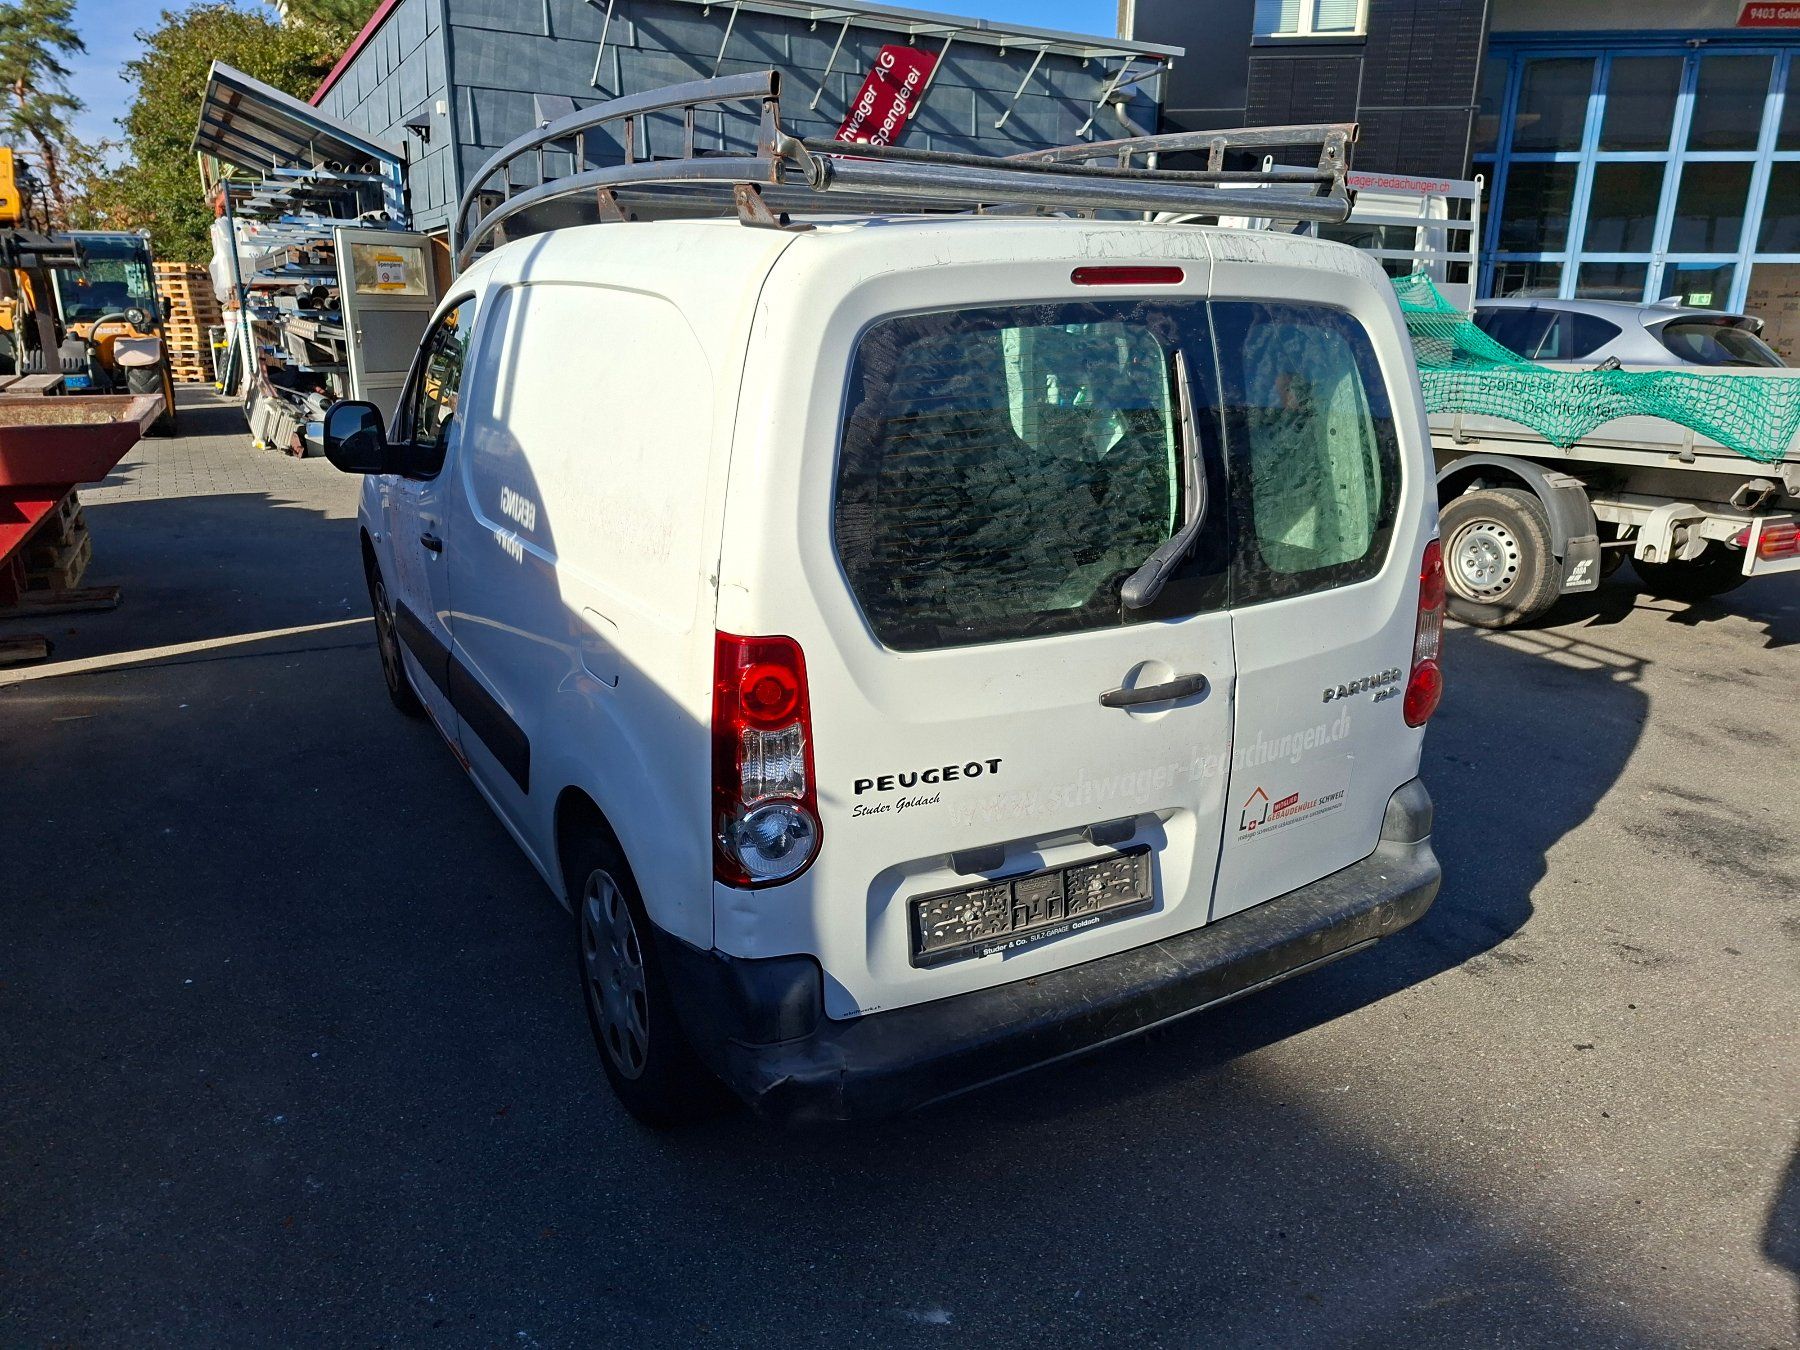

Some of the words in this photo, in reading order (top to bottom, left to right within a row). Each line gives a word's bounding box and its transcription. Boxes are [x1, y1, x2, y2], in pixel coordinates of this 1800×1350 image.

[1751, 8, 1775, 19] 9403
[875, 52, 895, 82] AG
[870, 65, 921, 146] Spenglerei
[1323, 667, 1402, 703] PARTNER
[854, 758, 1002, 795] PEUGEOT
[852, 803, 891, 818] Studer
[896, 792, 941, 813] Goldach
[1319, 789, 1344, 805] SCHWEIZ
[983, 944, 1006, 956] Studer
[1008, 941, 1015, 949] &
[1016, 938, 1028, 947] Co.
[1030, 924, 1069, 942] SULZ-GARAGE
[1072, 917, 1100, 930] Goldach
